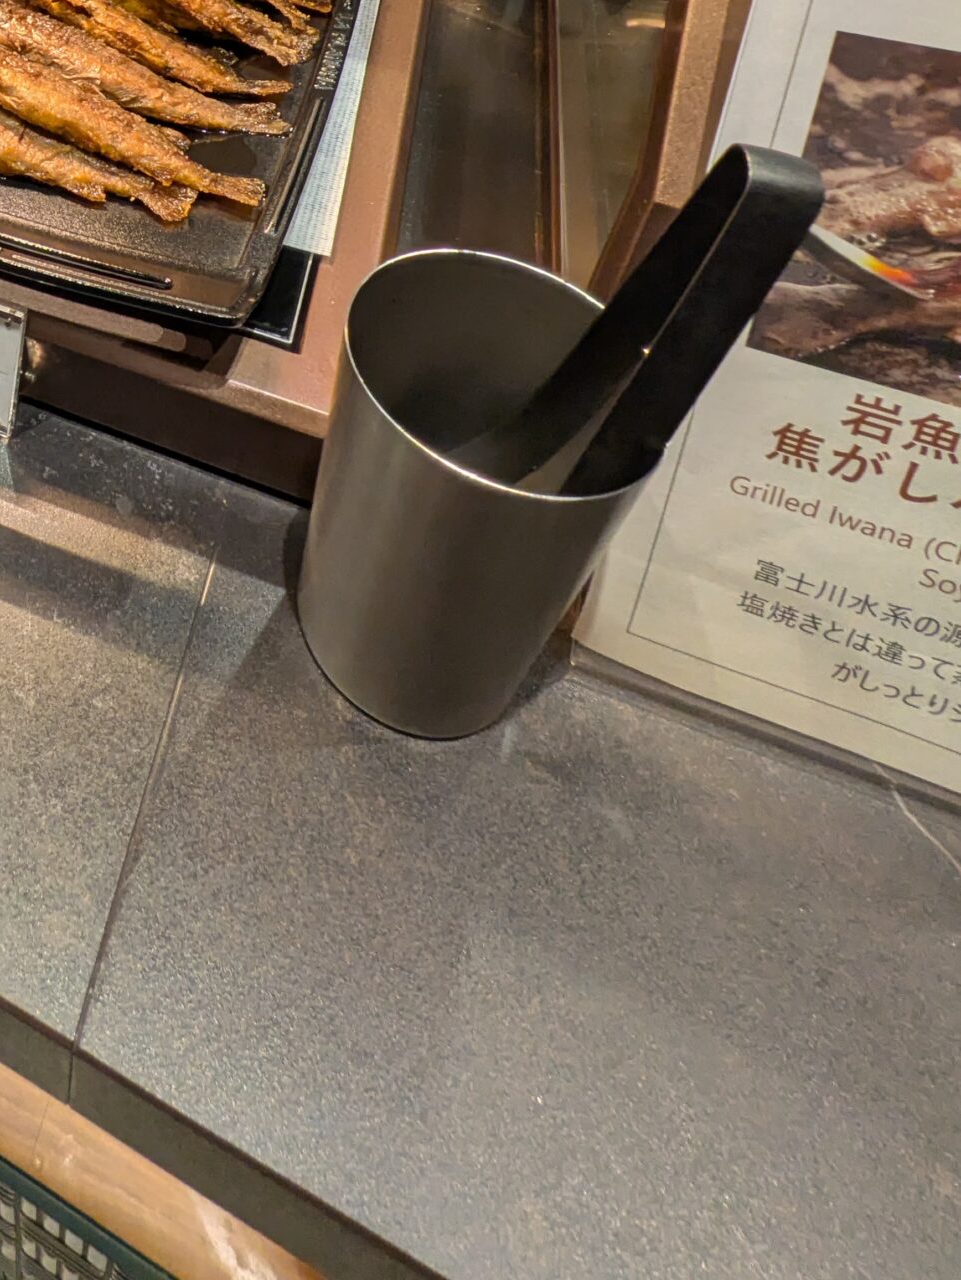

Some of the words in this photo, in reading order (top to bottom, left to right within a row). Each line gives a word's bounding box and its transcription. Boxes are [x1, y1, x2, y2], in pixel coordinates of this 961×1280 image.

[765, 422, 961, 509] 焦がし
[839, 392, 961, 465] 岩魚
[730, 475, 820, 519] Grilled
[828, 506, 914, 550] Iwana
[924, 536, 961, 565] (C
